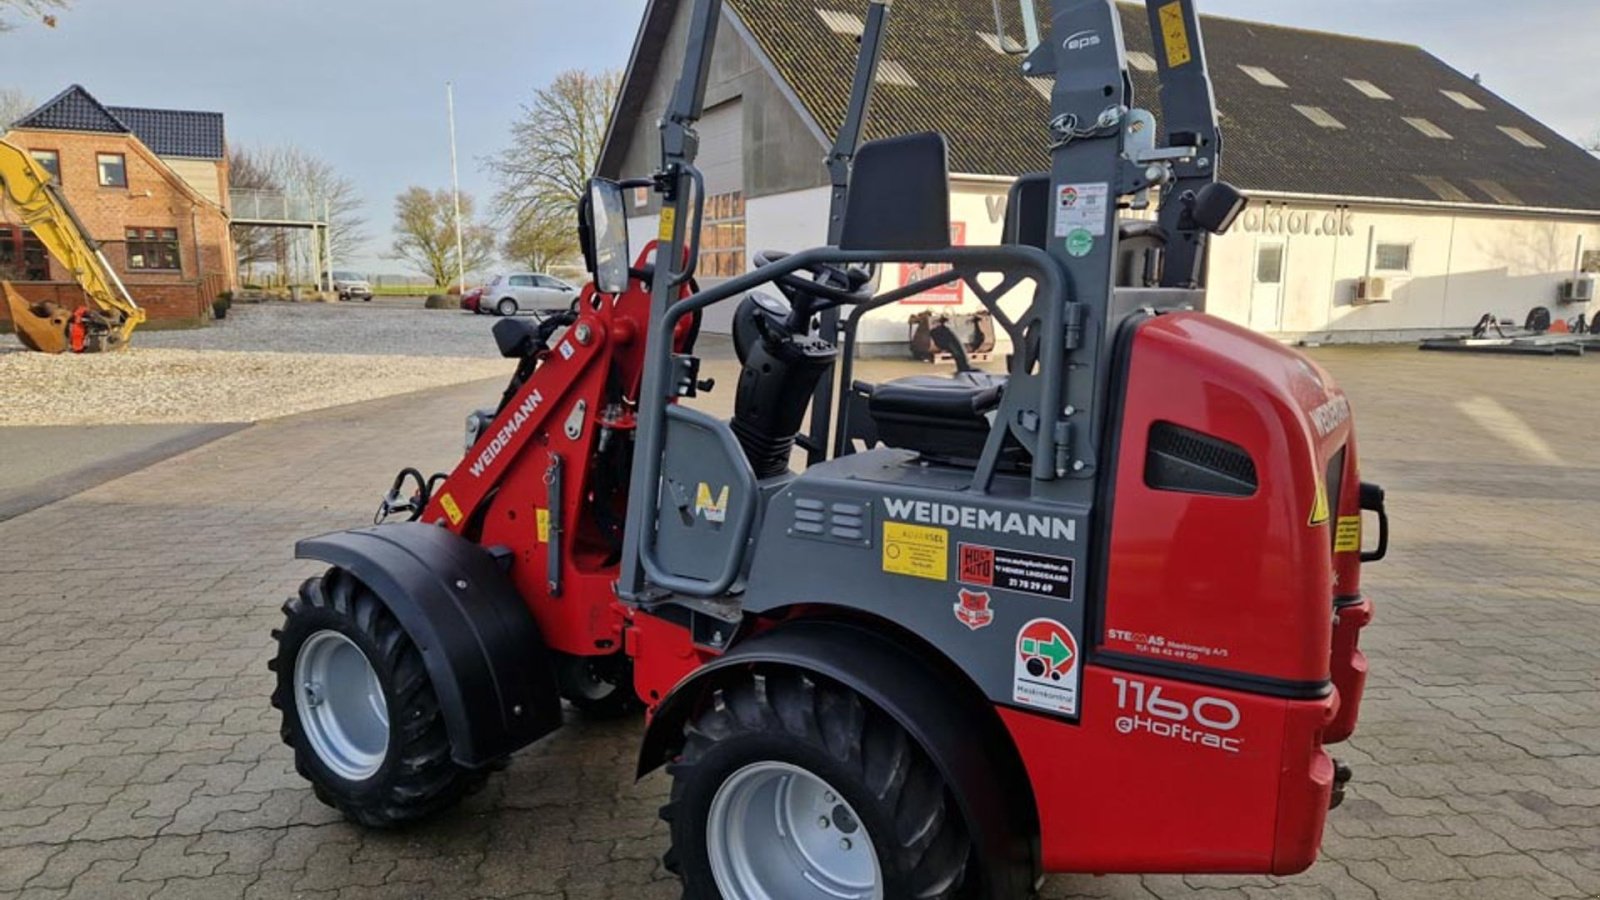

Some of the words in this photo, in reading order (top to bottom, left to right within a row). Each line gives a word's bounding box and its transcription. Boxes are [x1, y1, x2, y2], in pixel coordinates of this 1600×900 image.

[1068, 35, 1100, 50] eps
[470, 388, 544, 478] WEIDEMANN
[883, 497, 1076, 541] WEIDEMANN
[963, 559, 990, 578] AUTO
[1108, 629, 1165, 646] STEMAS
[1112, 677, 1241, 731] 1160
[1115, 716, 1241, 753] eHoftrac
